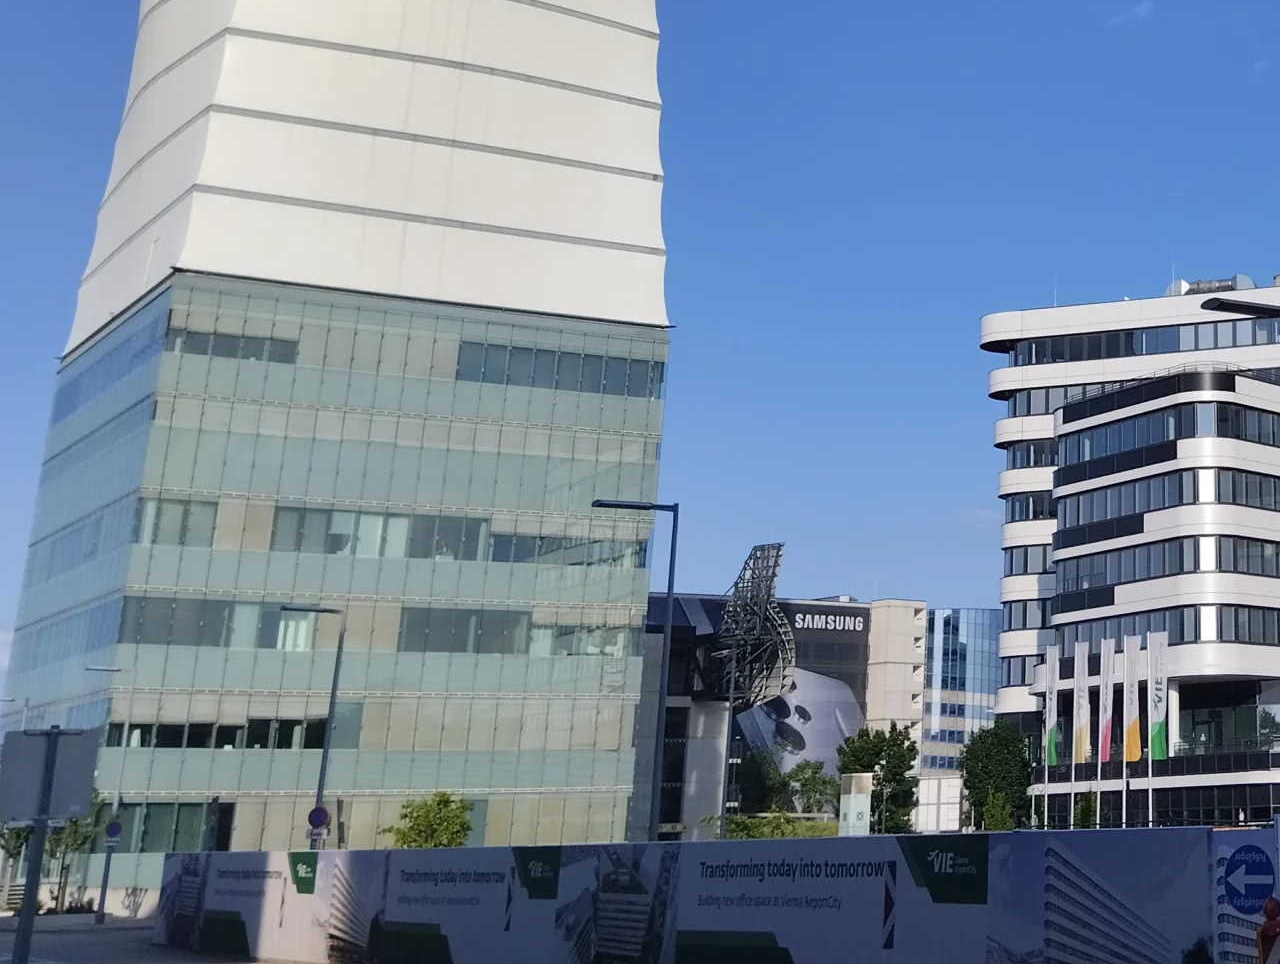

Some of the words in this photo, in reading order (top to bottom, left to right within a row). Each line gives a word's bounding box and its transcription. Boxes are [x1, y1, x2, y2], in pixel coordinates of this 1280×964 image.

[794, 613, 864, 632] SAMSUNG
[1155, 676, 1164, 704] VIE
[700, 857, 765, 883] Transforming
[767, 857, 798, 883] today
[799, 857, 822, 878] into
[824, 860, 886, 878] tomorrow
[933, 852, 955, 873] VIE
